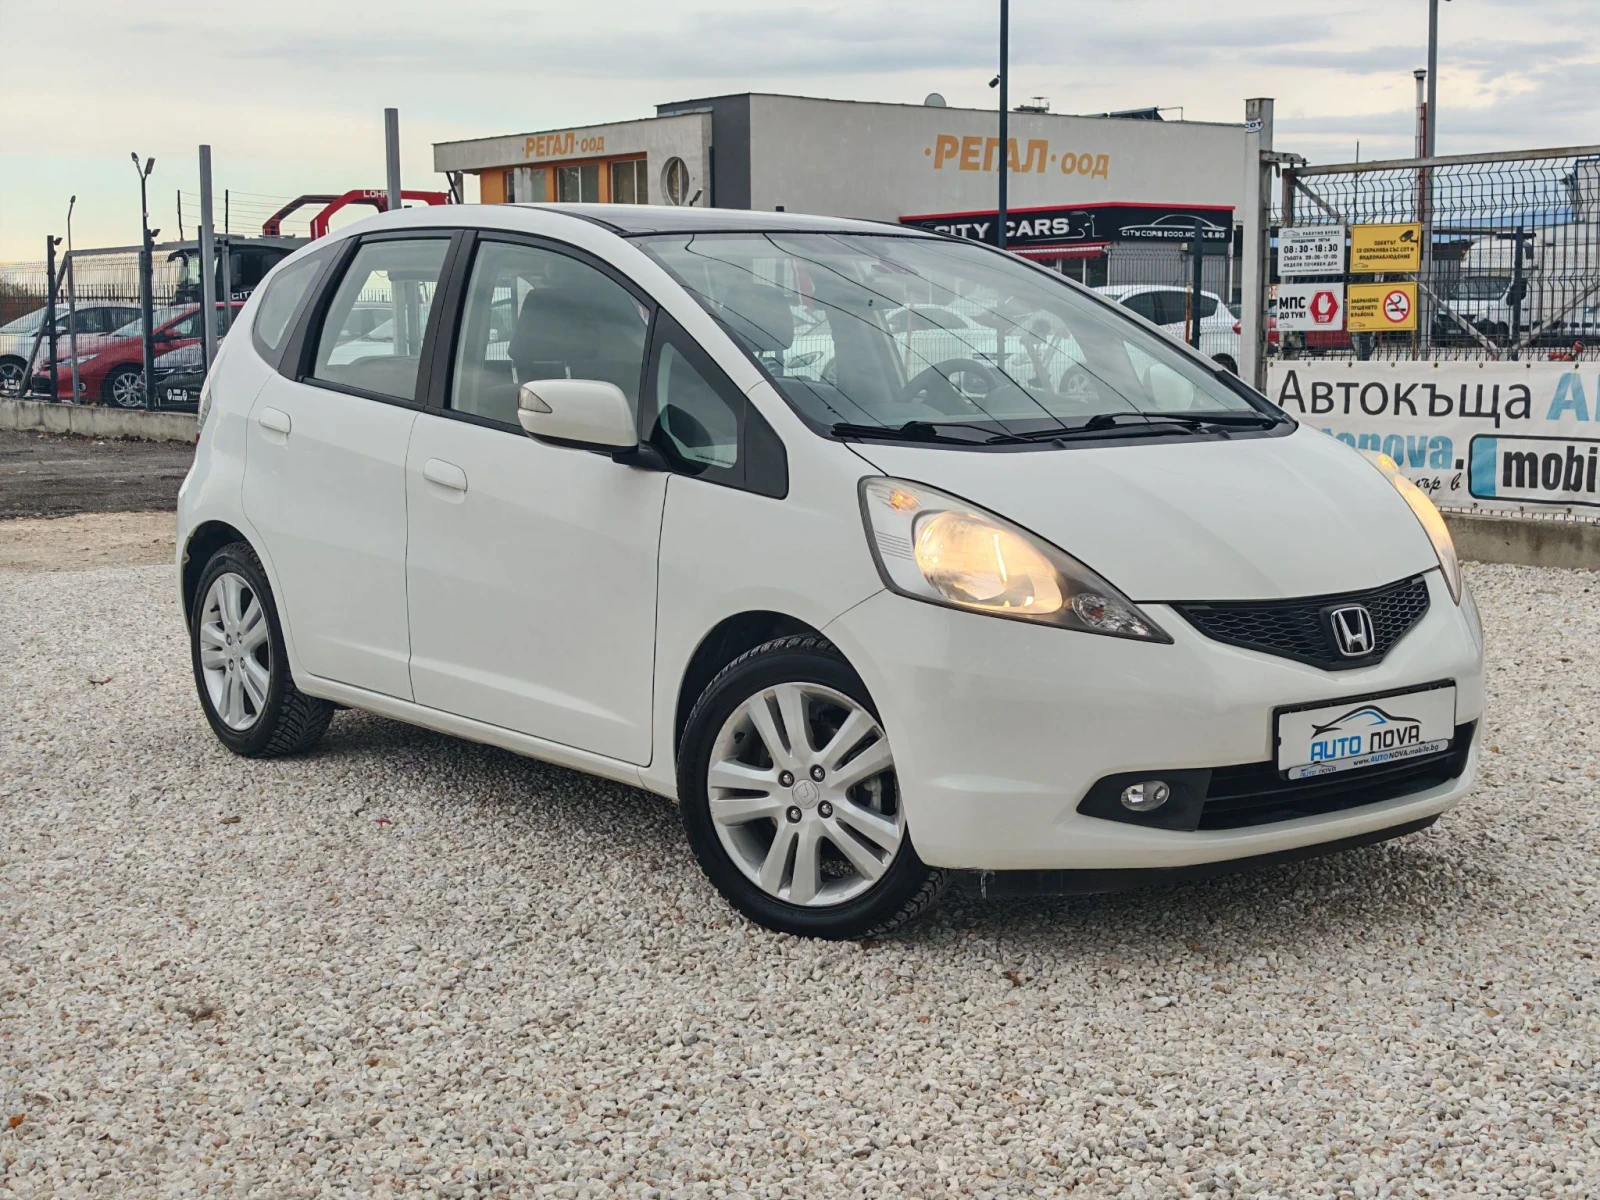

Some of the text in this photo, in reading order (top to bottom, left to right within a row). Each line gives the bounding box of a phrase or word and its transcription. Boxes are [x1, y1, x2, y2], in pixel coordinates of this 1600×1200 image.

[525, 132, 575, 158] РЕГАЛ
[933, 134, 1049, 173] РЕГАЛ
[1006, 218, 1070, 237] CARS
[231, 290, 253, 300] CIT
[1279, 296, 1306, 309] МПС
[1279, 311, 1306, 320] ДО ТУК!
[1278, 369, 1531, 428] Автокъща
[1310, 735, 1362, 762] AUTO
